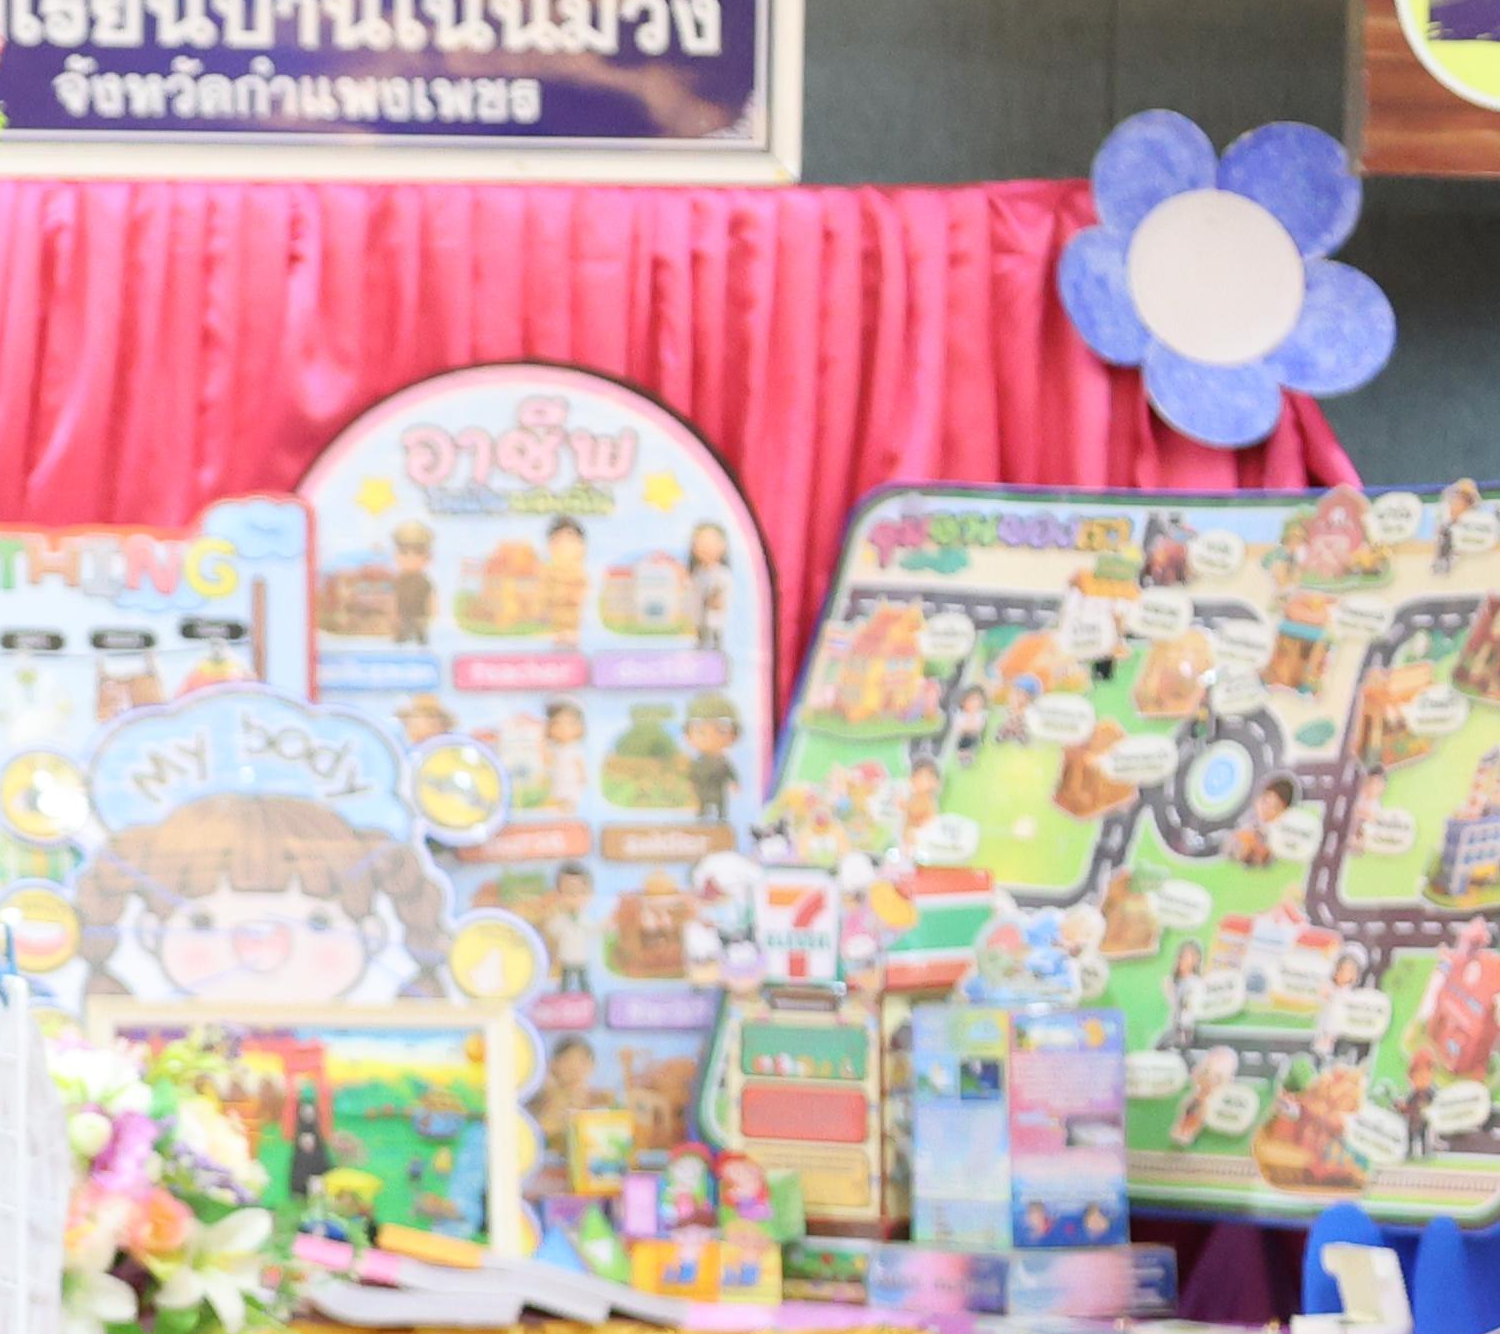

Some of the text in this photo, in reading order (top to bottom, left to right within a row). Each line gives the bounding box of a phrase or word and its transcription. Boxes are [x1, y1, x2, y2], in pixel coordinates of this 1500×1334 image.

[51, 59, 542, 125] จังหวัดกำแพงเพชร
[402, 394, 638, 486] อาชีพ
